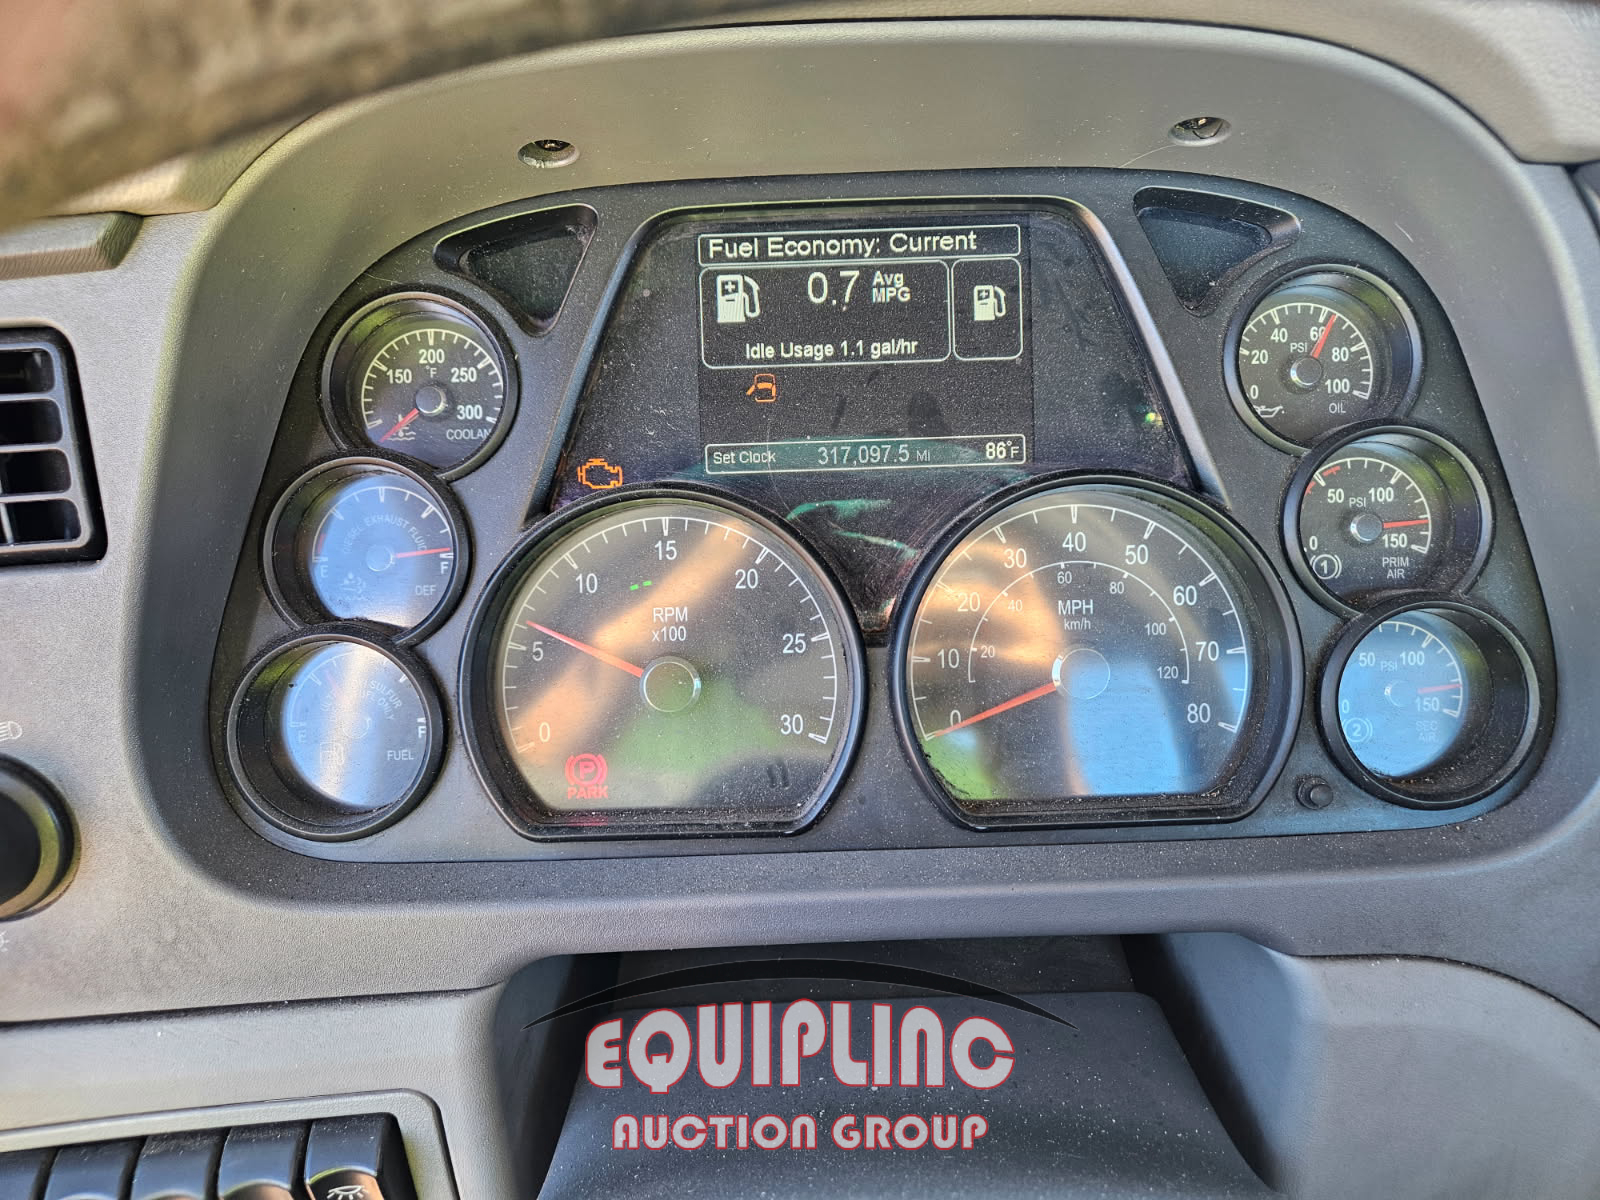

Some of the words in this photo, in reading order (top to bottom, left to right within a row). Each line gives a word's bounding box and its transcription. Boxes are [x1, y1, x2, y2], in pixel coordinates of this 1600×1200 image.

[709, 238, 758, 258] Fuel
[767, 236, 880, 257] Economy:
[890, 231, 977, 252] Current
[872, 271, 904, 288] Avg
[808, 270, 859, 305] 0.7
[872, 286, 911, 303] MPG
[1271, 328, 1288, 342] 40
[1310, 326, 1326, 341] 60
[746, 343, 775, 360] Idle
[780, 341, 834, 360] Usage
[840, 340, 864, 356] 1.1
[870, 339, 918, 358] gal/hr
[1290, 342, 1308, 353] PSI
[1332, 347, 1349, 361] 80
[419, 349, 445, 364] 200
[1251, 350, 1268, 364] 20
[386, 369, 412, 384] 150
[451, 367, 477, 382] 250
[1250, 385, 1259, 399] 0
[1325, 379, 1350, 393] 100
[457, 405, 483, 420] 300
[1329, 403, 1347, 413] OIL
[446, 429, 491, 440] COOLAN
[713, 452, 736, 465] Set
[739, 450, 776, 464] Clock
[818, 444, 910, 466] 317,097.5
[916, 450, 931, 462] MI
[1327, 488, 1344, 503] 50
[1349, 497, 1366, 507] PSI
[1368, 487, 1394, 502] 100
[364, 513, 410, 529] EXHAUST
[1062, 532, 1087, 552] 40
[1309, 536, 1318, 551] 0
[1382, 533, 1408, 548] 150
[654, 540, 678, 561] 15
[1003, 548, 1027, 568] 30
[1125, 544, 1149, 565] 50
[440, 562, 449, 574] F
[1320, 560, 1328, 574] 1
[1382, 556, 1409, 567] PRIM
[320, 565, 329, 578] E
[735, 569, 759, 589] 20
[1057, 571, 1072, 585] 60
[1386, 568, 1405, 579] AIR
[415, 585, 437, 595] DEF
[575, 573, 598, 593] 10
[1109, 581, 1125, 595] 80
[957, 592, 980, 612] 20
[1173, 586, 1197, 606] 60
[1008, 599, 1023, 613] 40
[1057, 600, 1094, 615] MPH
[652, 607, 688, 622] RPM
[1063, 617, 1091, 630] km/h
[1144, 622, 1167, 636] 100
[651, 626, 687, 642] x100
[782, 633, 806, 654] 25
[1196, 641, 1220, 661] 70
[531, 642, 544, 661] 5
[937, 649, 960, 669] 10
[980, 645, 995, 659] 20
[1401, 651, 1425, 666] 100
[1359, 652, 1375, 667] 50
[1380, 660, 1398, 671] PSI
[1157, 666, 1179, 679] 120
[369, 680, 403, 709] SULFUR
[1341, 699, 1349, 713] 0
[1416, 697, 1440, 711] 150
[950, 710, 961, 727] 0
[1187, 703, 1210, 723] 80
[417, 725, 426, 738] F
[538, 722, 551, 742] 0
[780, 714, 804, 735] 30
[1352, 723, 1361, 737] 2
[387, 750, 414, 760] FUEL
[567, 785, 608, 799] PARK
